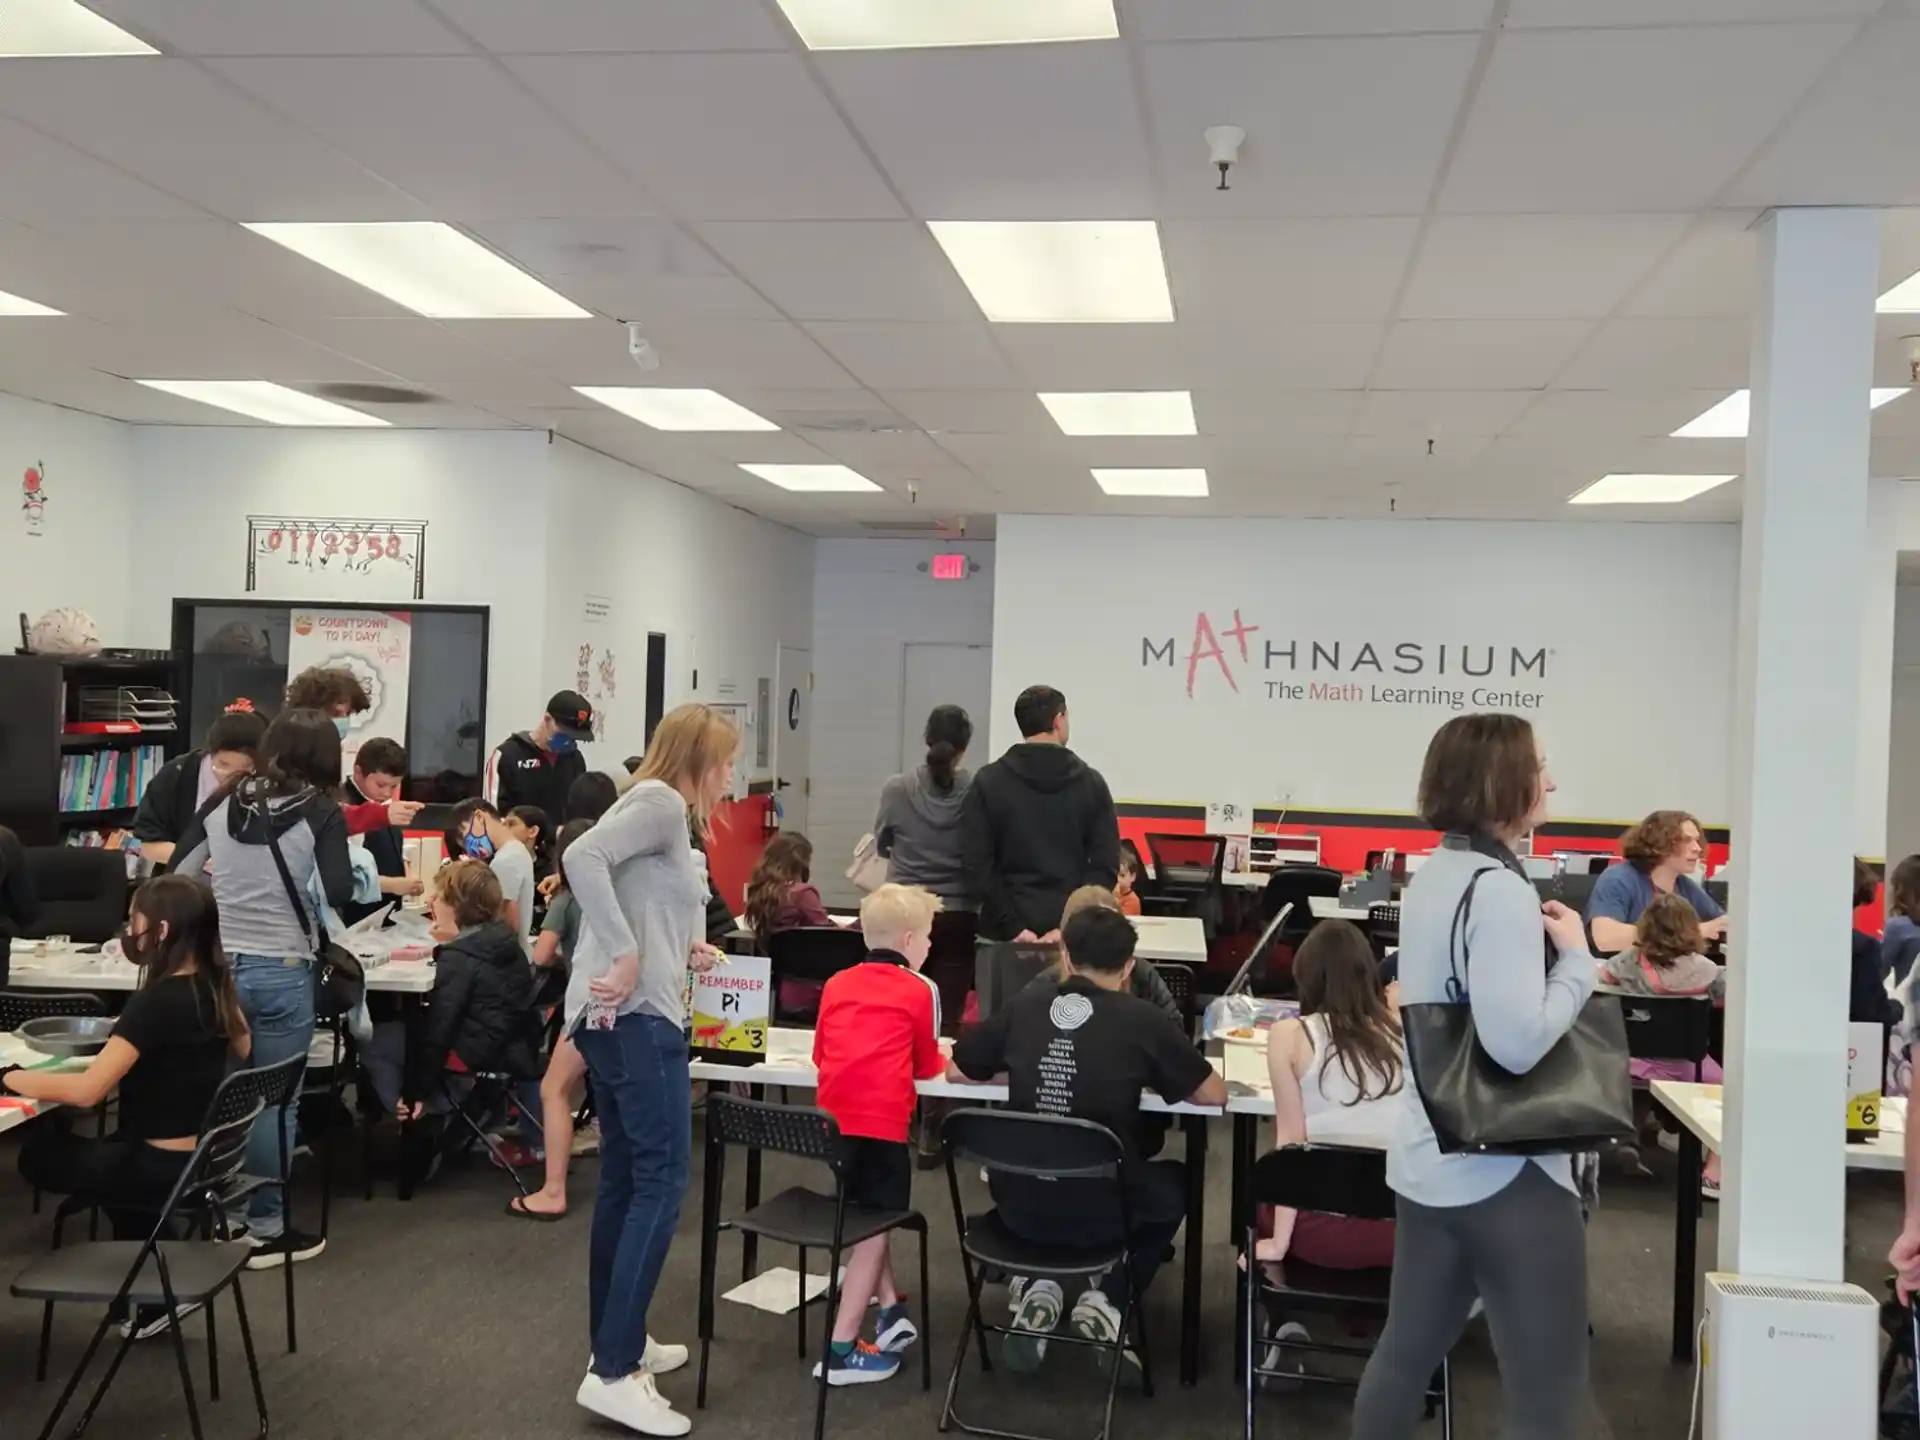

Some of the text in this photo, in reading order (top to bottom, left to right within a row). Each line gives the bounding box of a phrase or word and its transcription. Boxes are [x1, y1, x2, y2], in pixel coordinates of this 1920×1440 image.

[318, 617, 388, 629] COUNTDOWN
[325, 630, 339, 641] TO
[355, 630, 381, 642] DAY!
[1264, 680, 1544, 710] The Math Learning Center
[699, 975, 764, 990] REMEMBER
[721, 992, 740, 1013] Pi
